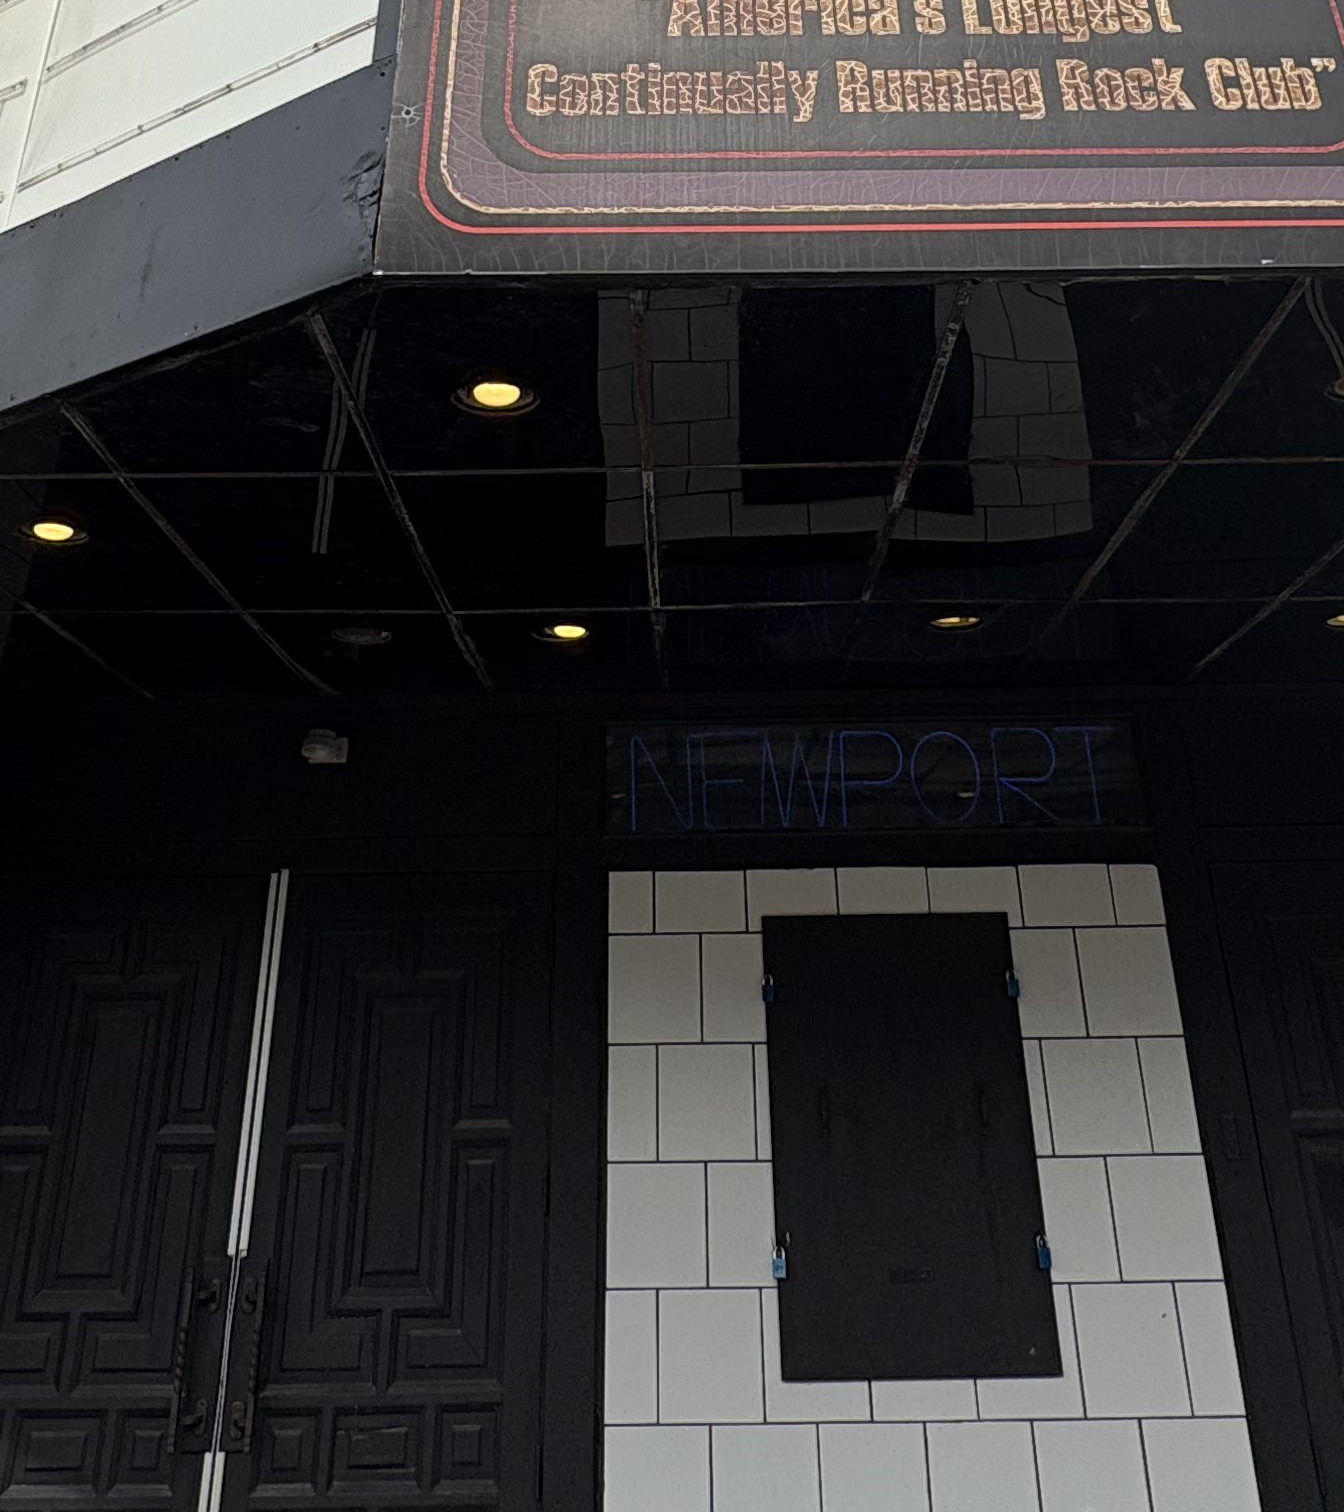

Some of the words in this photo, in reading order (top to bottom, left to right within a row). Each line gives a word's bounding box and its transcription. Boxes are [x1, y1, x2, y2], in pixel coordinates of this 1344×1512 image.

[526, 59, 819, 124] Continually
[836, 58, 1048, 122] Running
[1057, 56, 1187, 113] Rock
[630, 727, 1116, 833] NEWPORT
